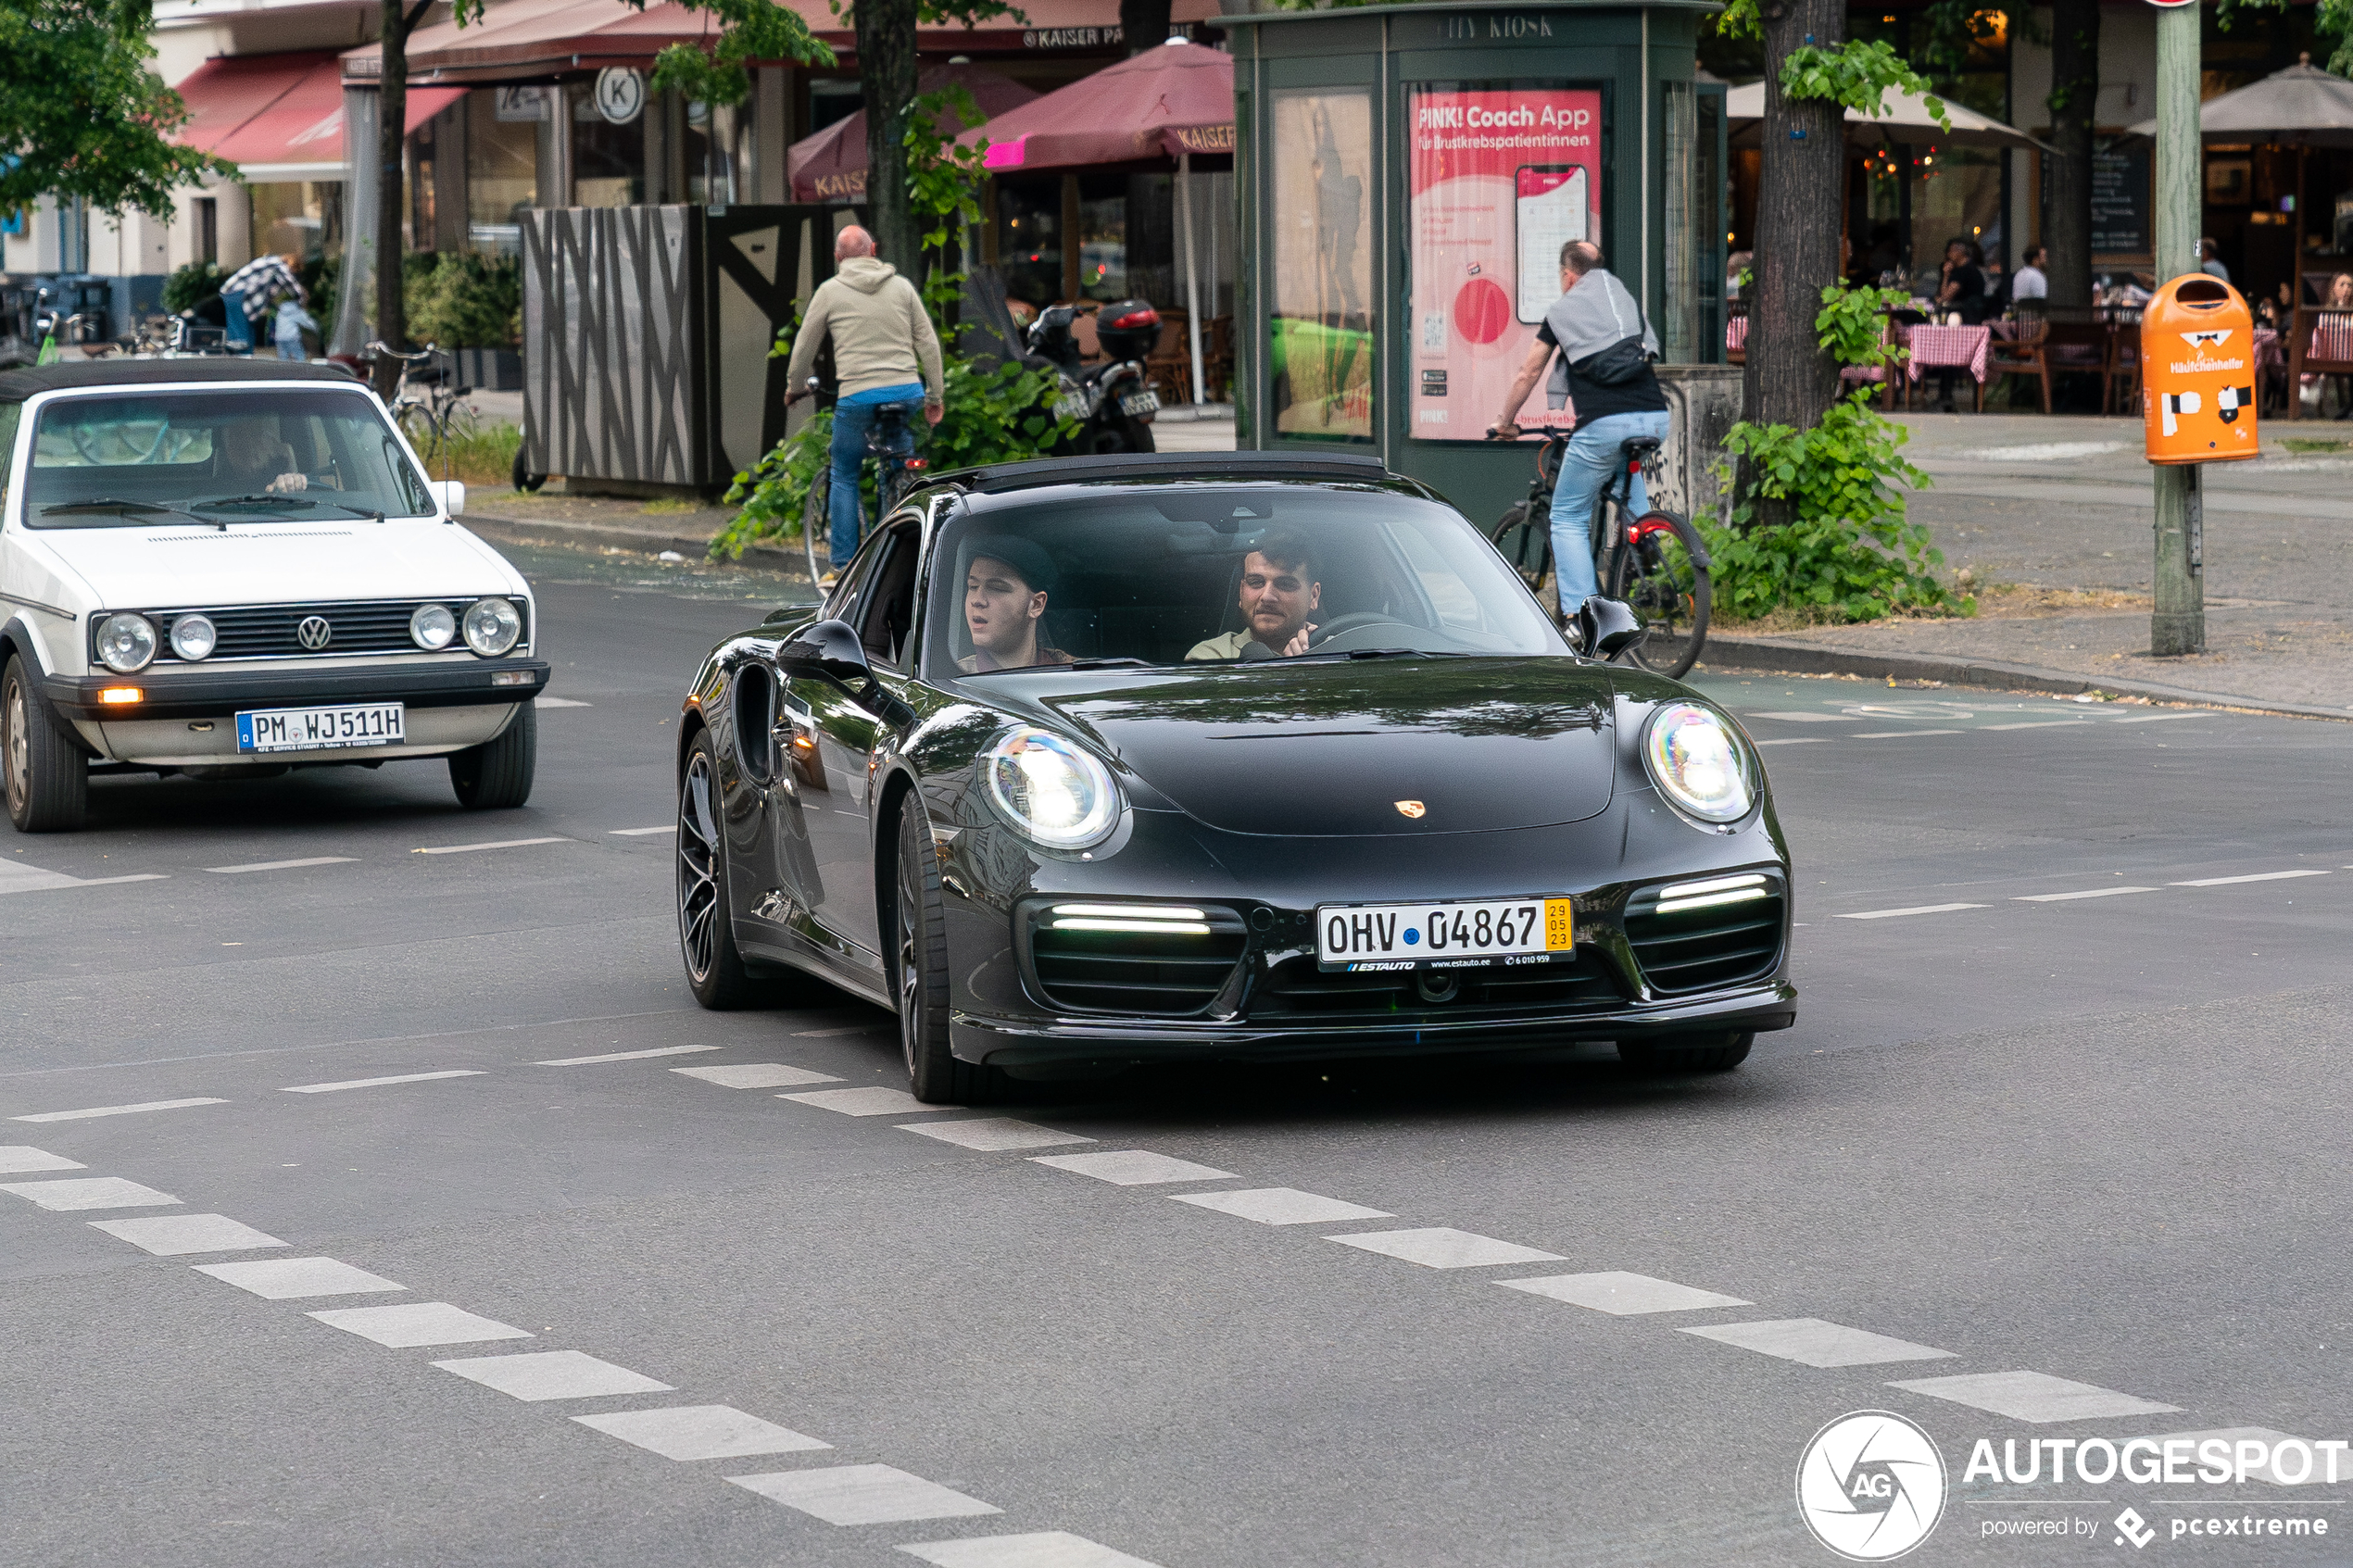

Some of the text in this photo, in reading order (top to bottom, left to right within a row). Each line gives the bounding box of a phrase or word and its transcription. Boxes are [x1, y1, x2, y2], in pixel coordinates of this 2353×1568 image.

[1038, 29, 1100, 47] KAISER
[611, 79, 628, 105] K
[1419, 104, 1591, 131] PINK! Coach App
[1433, 132, 1591, 152] Brustkrebspatientinnen
[2170, 358, 2244, 374] Häufchenhelfer
[255, 716, 286, 743] PM
[1550, 905, 1566, 917] 29
[1327, 907, 1537, 954] OHV 04867
[1550, 919, 1566, 931] 05
[1551, 933, 1567, 945] 23
[1358, 961, 1416, 972] ESTAUTO
[1431, 959, 1491, 968] www.estauto.ee
[1536, 955, 1550, 963] 959
